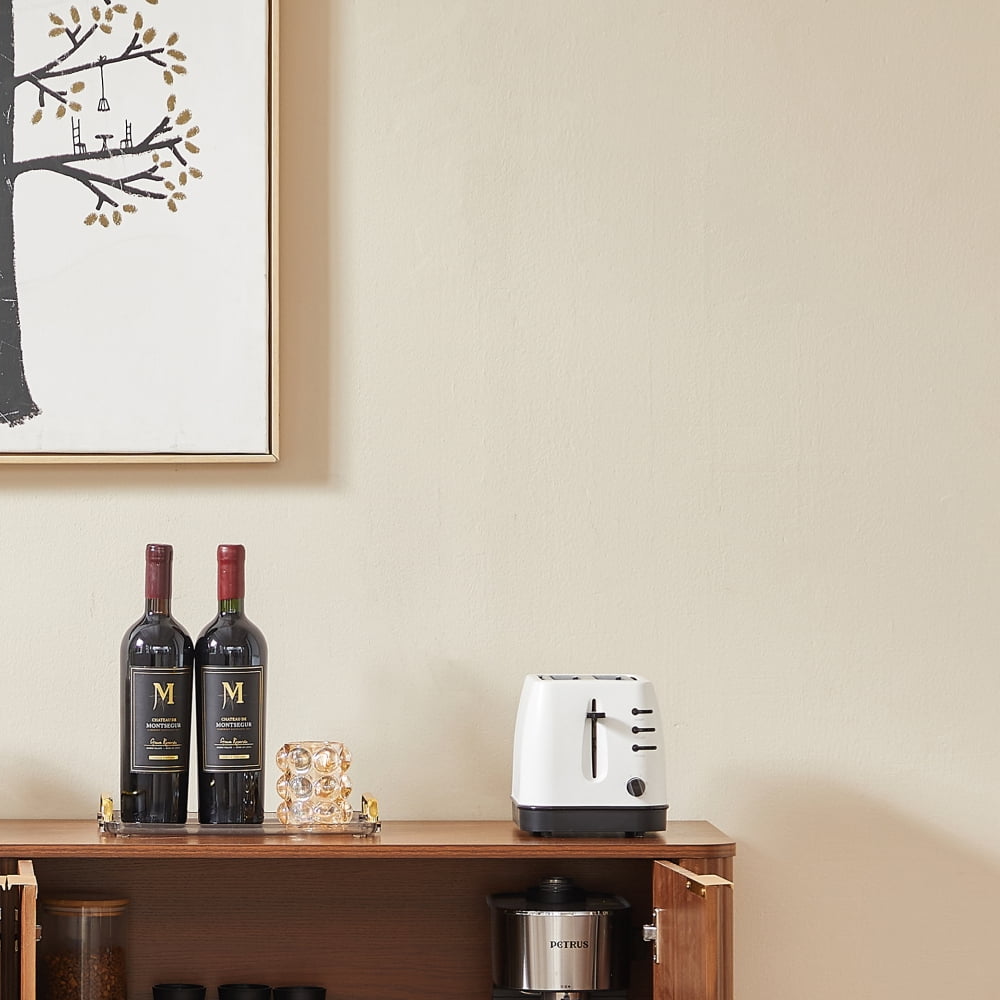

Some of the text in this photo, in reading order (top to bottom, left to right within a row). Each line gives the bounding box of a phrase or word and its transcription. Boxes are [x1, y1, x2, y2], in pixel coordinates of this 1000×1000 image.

[152, 682, 175, 711] M
[221, 681, 245, 710] M
[550, 940, 589, 949] PETRUS
